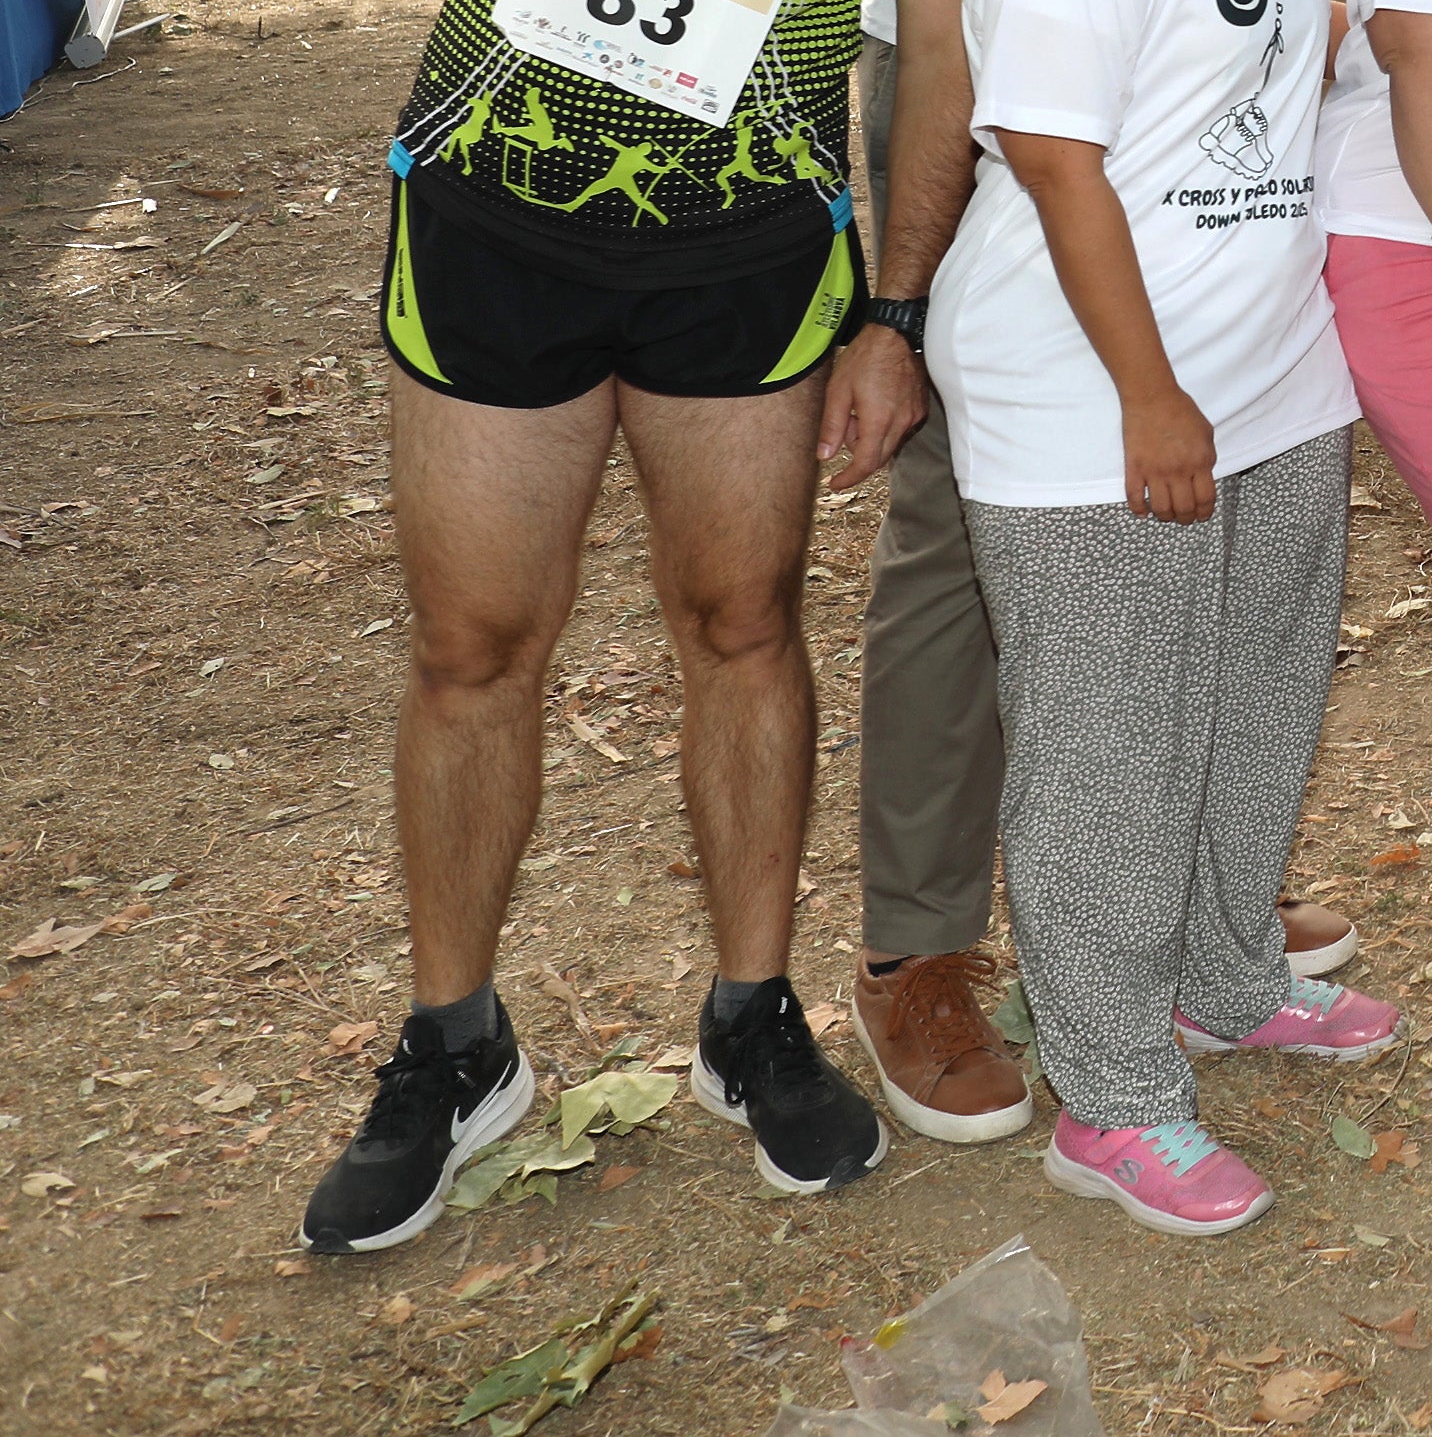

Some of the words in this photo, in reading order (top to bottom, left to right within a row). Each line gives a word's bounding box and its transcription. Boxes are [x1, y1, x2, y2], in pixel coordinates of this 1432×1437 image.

[1162, 189, 1176, 206] X
[1179, 188, 1227, 207] CROSS
[1231, 188, 1241, 206] Y
[1196, 211, 1241, 230] DOWN
